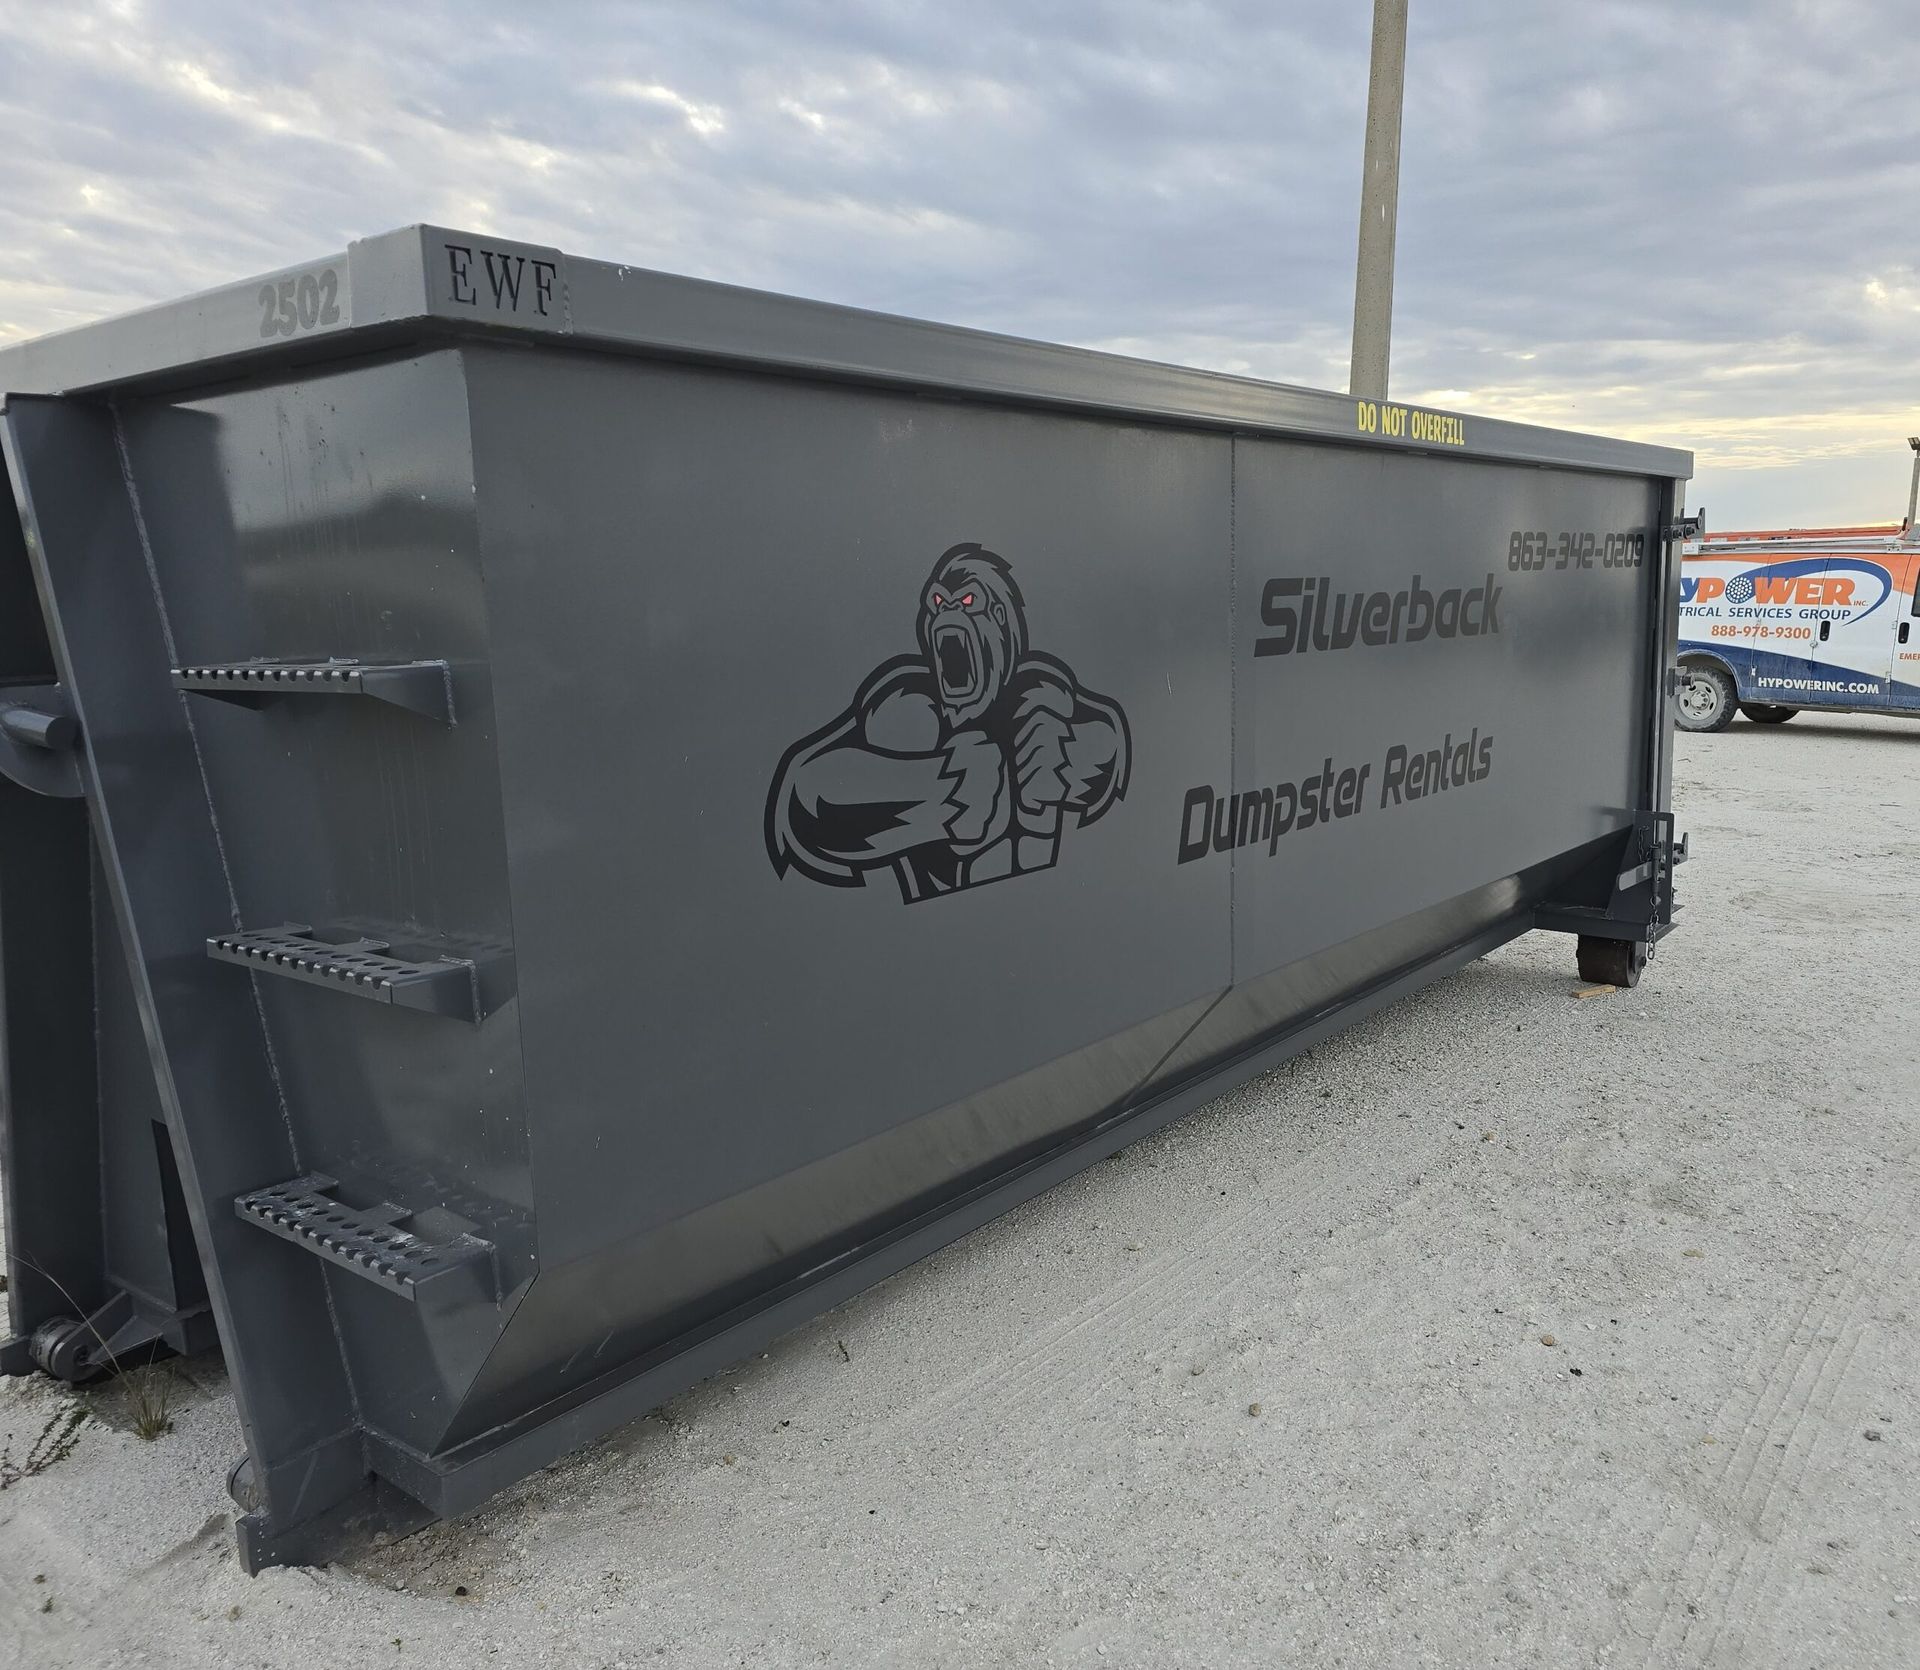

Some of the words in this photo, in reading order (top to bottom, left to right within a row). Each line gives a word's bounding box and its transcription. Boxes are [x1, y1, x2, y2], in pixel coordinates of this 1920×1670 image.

[445, 244, 557, 317] EWF
[258, 269, 341, 338] 2502
[1358, 401, 1377, 433] DO
[1381, 405, 1407, 437] NOT
[1411, 410, 1465, 446] OVERFILL
[1508, 531, 1645, 572] 863-342-0209
[1254, 573, 1502, 658] Silverback
[1711, 624, 1811, 639] 888-978-9300
[1728, 607, 1792, 619] SERVICES
[1799, 608, 1851, 620] GROUP
[1758, 677, 1880, 695] HYPOWERINC.COM
[1178, 757, 1371, 866] Dumpster
[1380, 727, 1494, 809] Rentals
